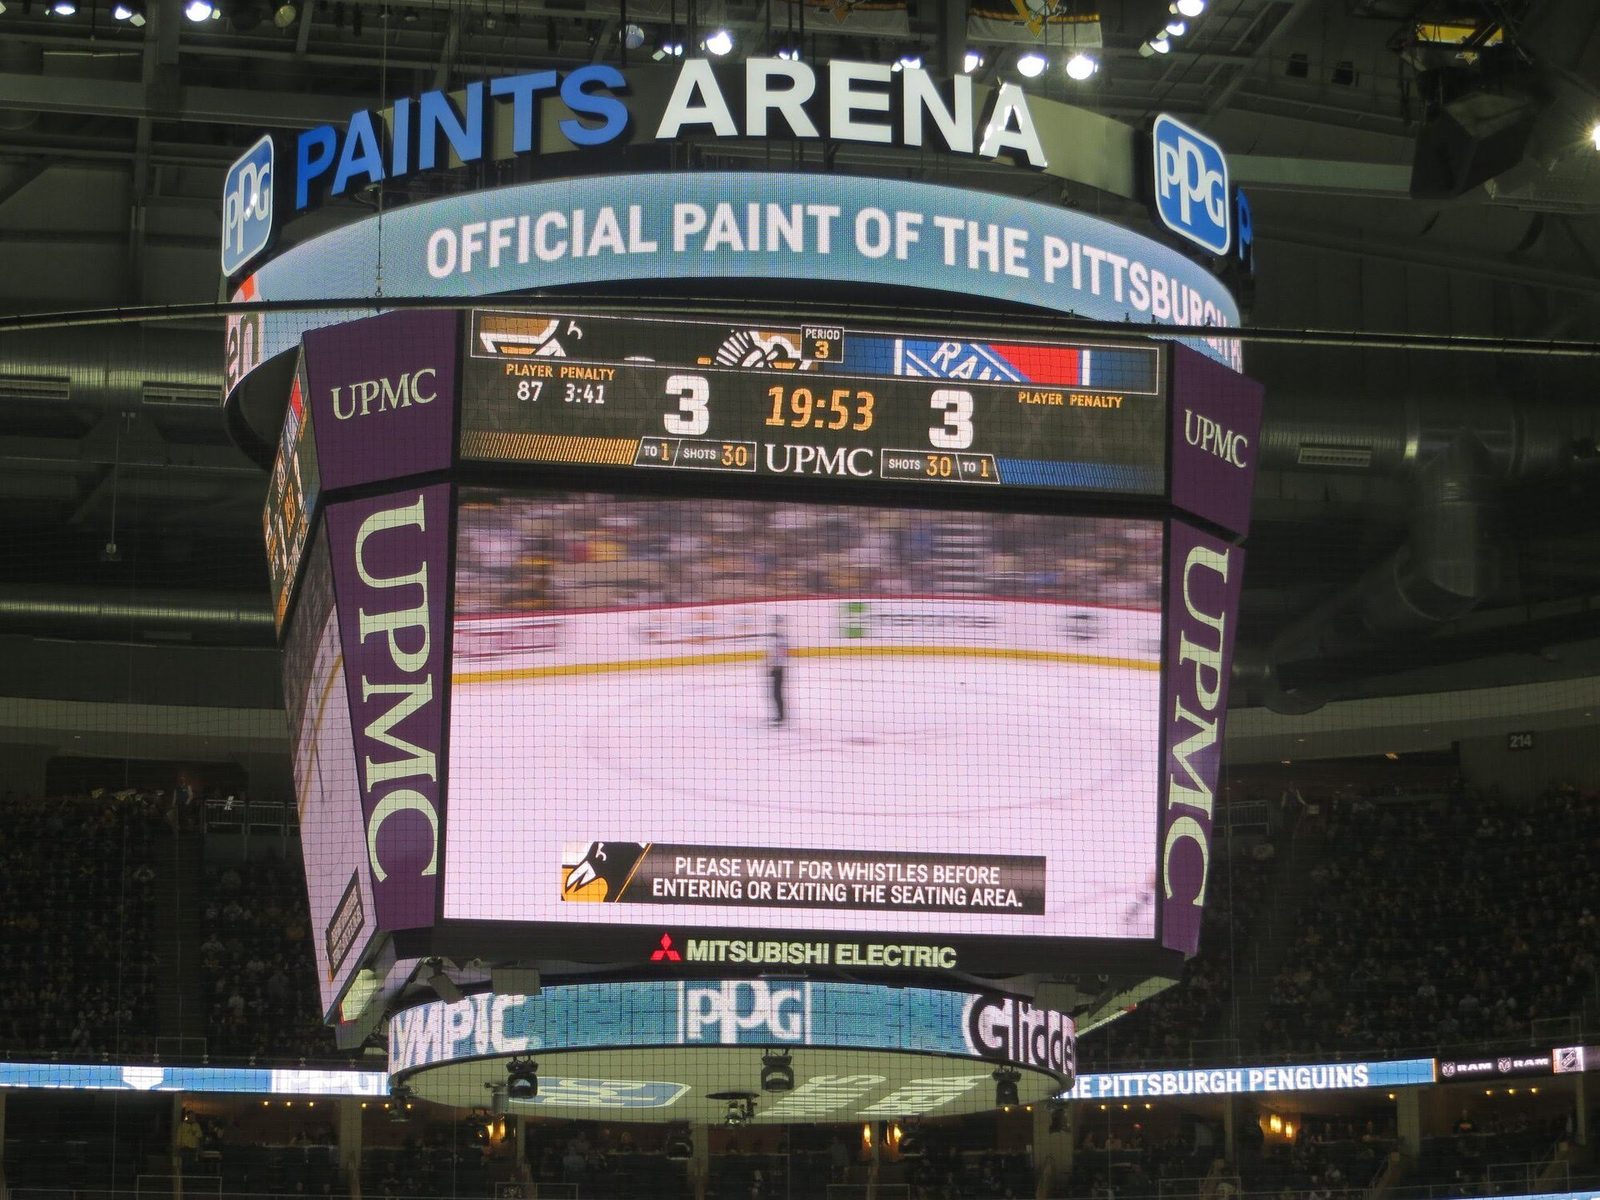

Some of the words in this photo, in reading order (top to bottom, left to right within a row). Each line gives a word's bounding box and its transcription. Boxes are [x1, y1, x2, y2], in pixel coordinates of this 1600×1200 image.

[295, 65, 628, 210] PAINTS
[655, 57, 1048, 169] ARENA
[1159, 136, 1225, 229] PPG
[225, 160, 271, 256] PPG
[426, 204, 657, 279] OFFICIAL
[673, 203, 839, 253] PAINT
[855, 208, 920, 260] OF
[933, 217, 1029, 278] THE
[805, 328, 840, 341] PERIOD
[814, 340, 829, 359] 3
[506, 364, 553, 378] PLAYER
[560, 366, 615, 381] PENALTY
[331, 368, 437, 420] UPMC
[517, 381, 543, 402] 87
[564, 383, 605, 404] 3:41
[664, 374, 710, 435] 3
[765, 385, 875, 431] 19:53
[1018, 391, 1064, 406] PLAYER
[1069, 394, 1122, 409] PENALTY
[928, 389, 974, 449] 3
[643, 446, 658, 457] TO
[660, 443, 670, 461] 1
[1184, 409, 1248, 468] UPMC
[683, 449, 717, 461] SHOTS
[721, 446, 748, 467] 30
[764, 444, 874, 477] UPMC
[888, 458, 921, 471] SHOTS
[926, 455, 952, 477] 30
[962, 460, 976, 473] TO
[979, 459, 989, 478] 1
[355, 494, 439, 882] UPMC
[1162, 546, 1229, 906] UPMC
[1509, 734, 1532, 748] 214
[674, 856, 742, 878] PLEASE
[746, 858, 794, 879] WAIT
[798, 860, 833, 881] FOR
[836, 862, 929, 884] WHISTLES
[933, 865, 1000, 886] BEFORE
[652, 878, 743, 899] ENTERING
[747, 881, 773, 900] OR
[776, 883, 847, 903] EXITING
[852, 885, 887, 904] THE
[890, 887, 967, 906] SEATING
[970, 889, 1024, 907] AREA.
[686, 938, 830, 965] MITSUBISHI
[835, 942, 957, 969] ELECTRIC
[687, 983, 802, 1044] PPG
[1457, 1062, 1492, 1072] RAM
[1513, 1058, 1549, 1068] RAM
[1098, 1071, 1242, 1097] PITTSBURGH
[1249, 1064, 1369, 1091] PENGUINS
